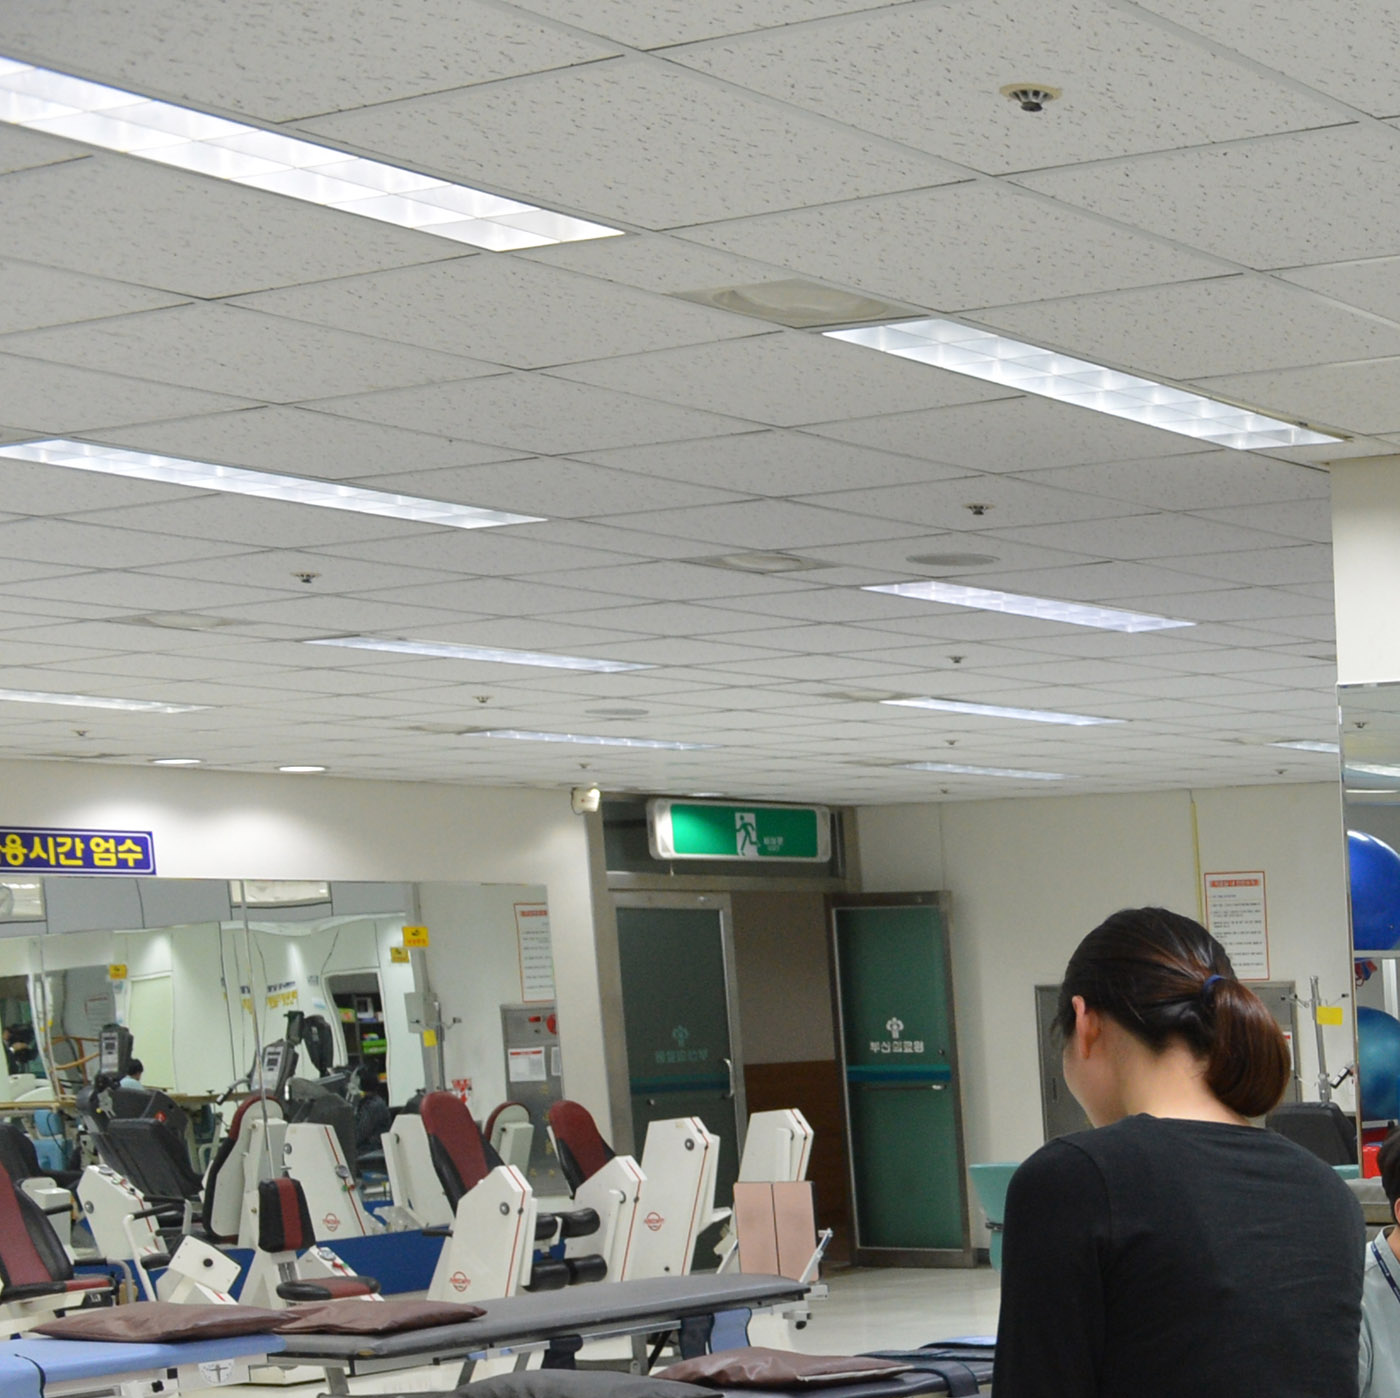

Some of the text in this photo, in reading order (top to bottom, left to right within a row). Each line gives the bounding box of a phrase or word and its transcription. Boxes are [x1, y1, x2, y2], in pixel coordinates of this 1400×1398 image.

[0, 833, 144, 867] 용시간 엄수
[869, 1040, 924, 1053] 부산의료원
